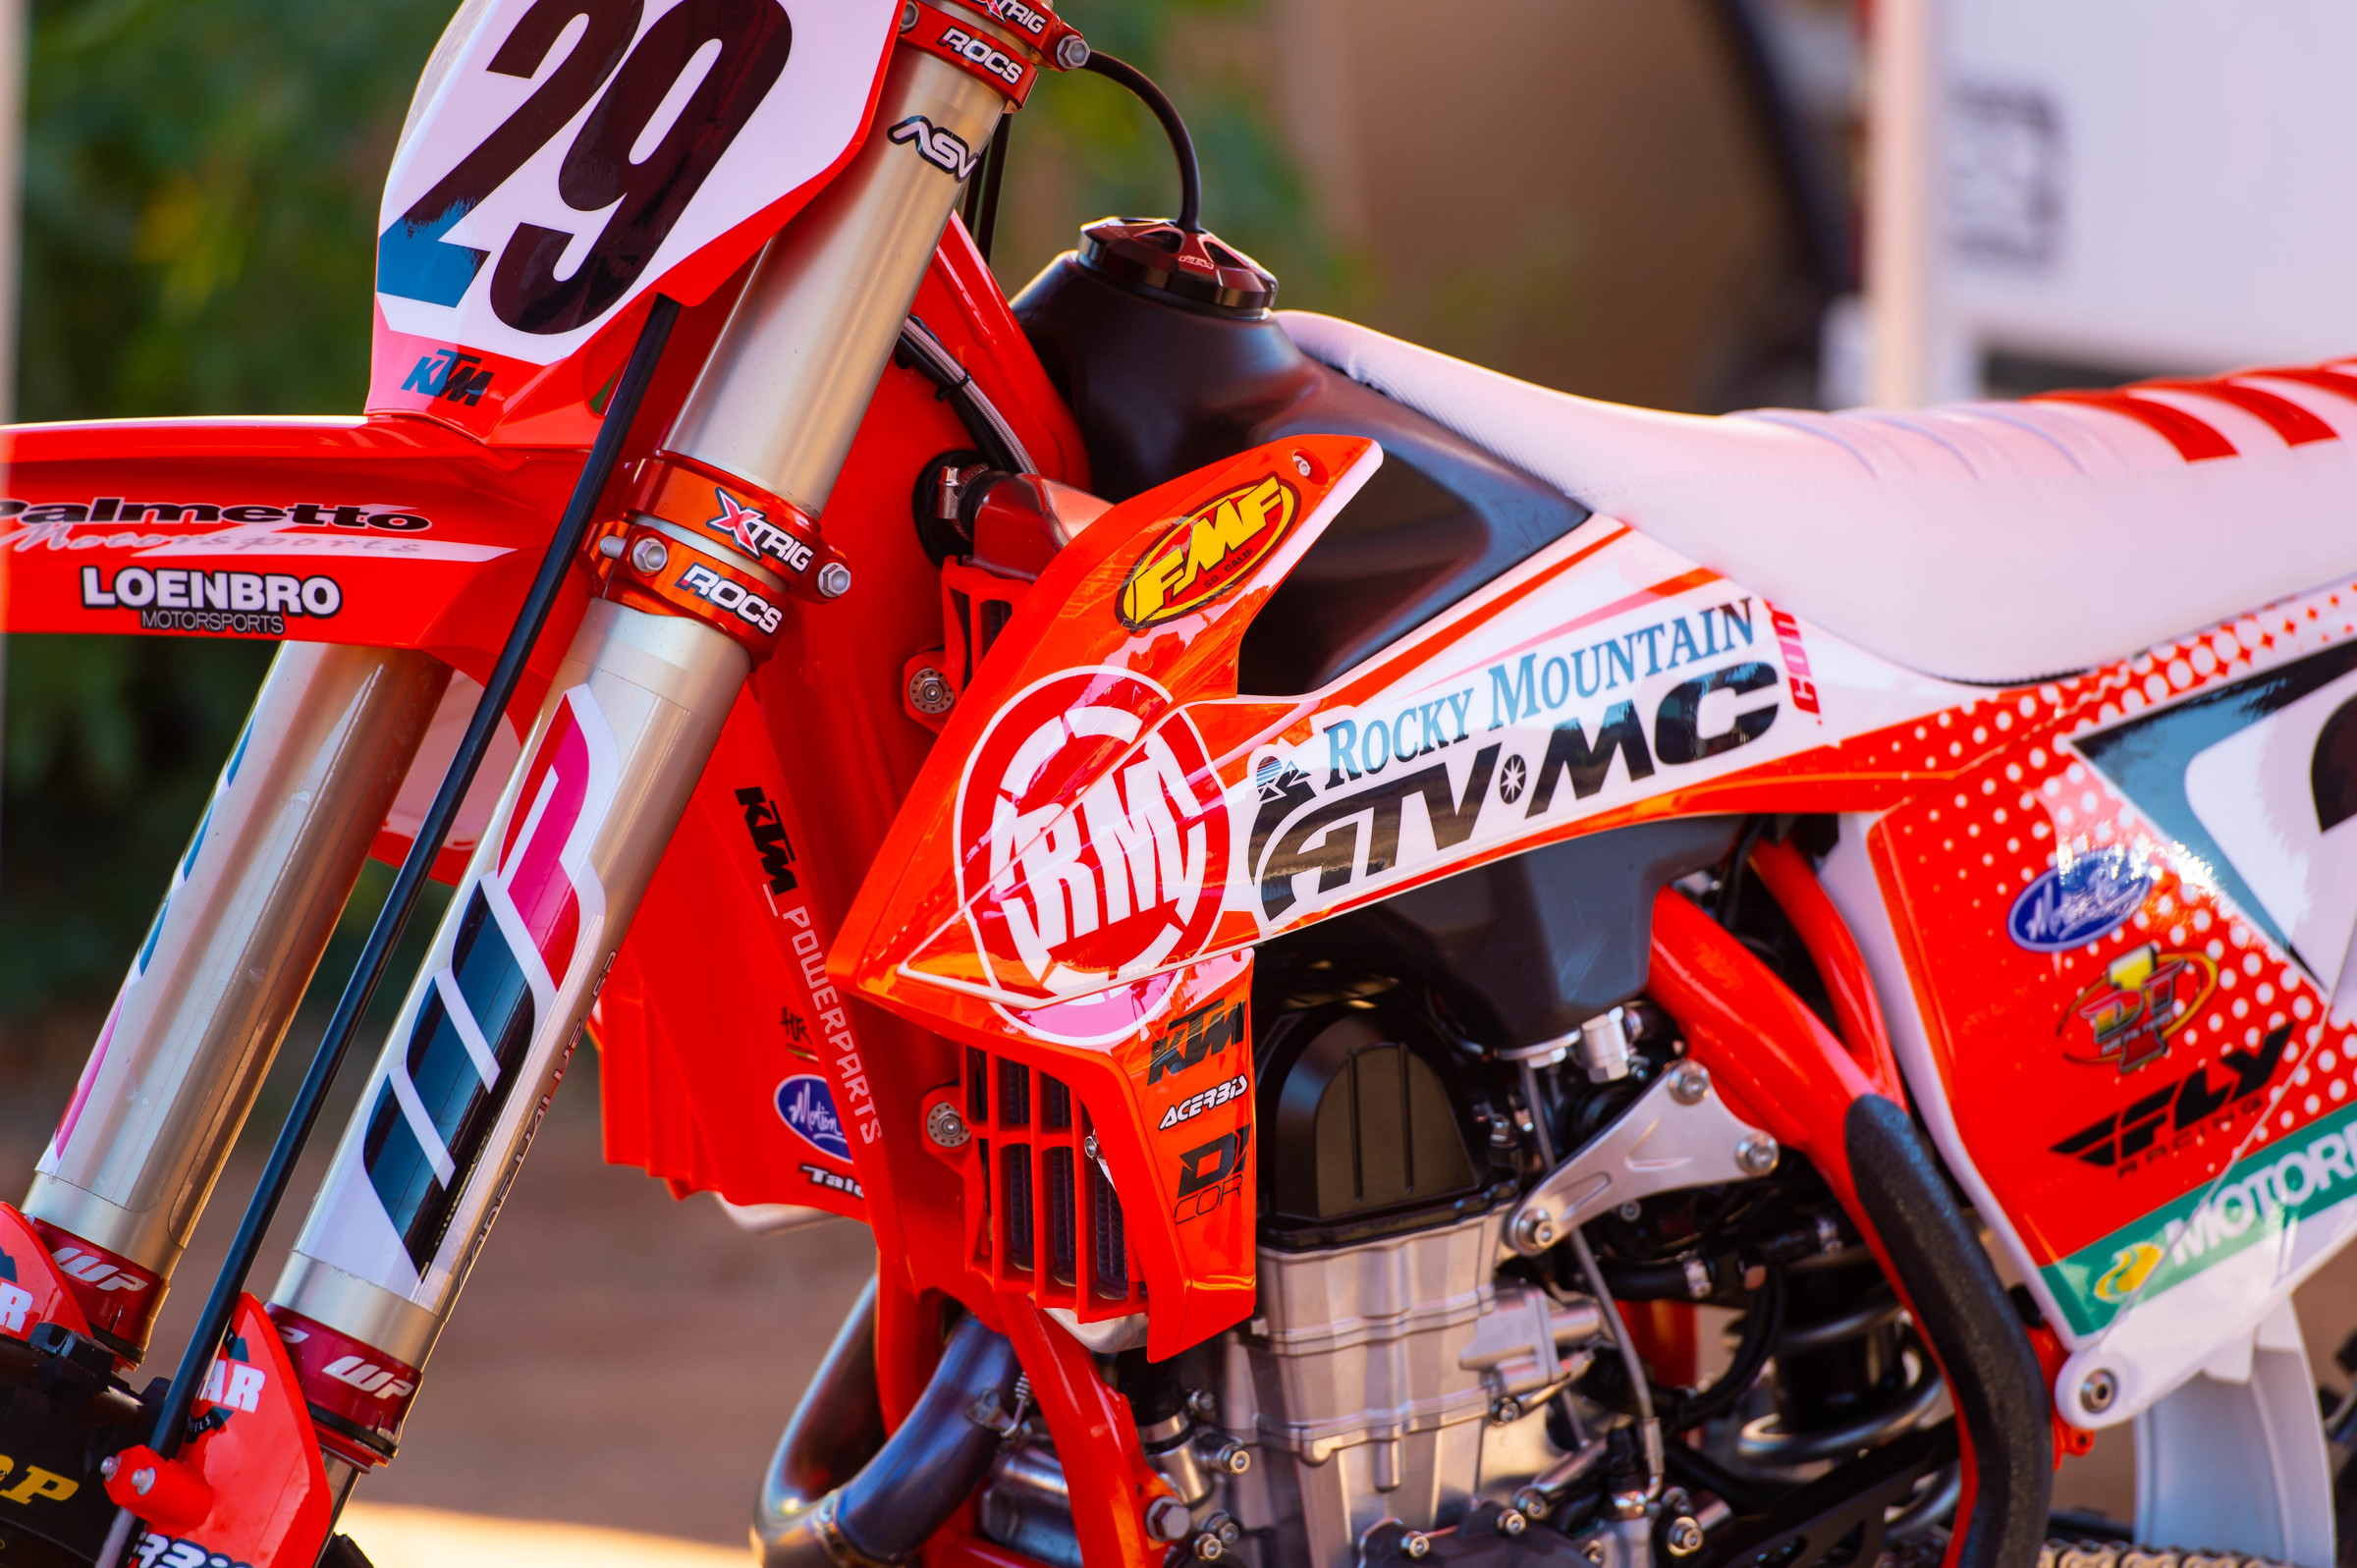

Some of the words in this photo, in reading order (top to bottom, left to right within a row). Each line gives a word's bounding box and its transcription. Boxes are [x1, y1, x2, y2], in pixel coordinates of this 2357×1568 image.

[940, 27, 1023, 84] ROCS
[376, 0, 793, 335] 29
[888, 116, 979, 183] ASV
[401, 349, 495, 407] KTM
[706, 487, 815, 575] XTRIG
[1134, 475, 1283, 625] FMF
[81, 565, 342, 617] LOENBRO
[141, 609, 285, 634] MOTORSPORTS
[676, 563, 785, 637] ROCS
[1323, 687, 1474, 789] ROCKY
[1488, 596, 1754, 730] MOUNTAIN
[1147, 998, 1245, 1086] KTM
[2050, 1020, 2294, 1166] FLY
[2117, 1098, 2262, 1177] RACING
[322, 1355, 413, 1400] WP
